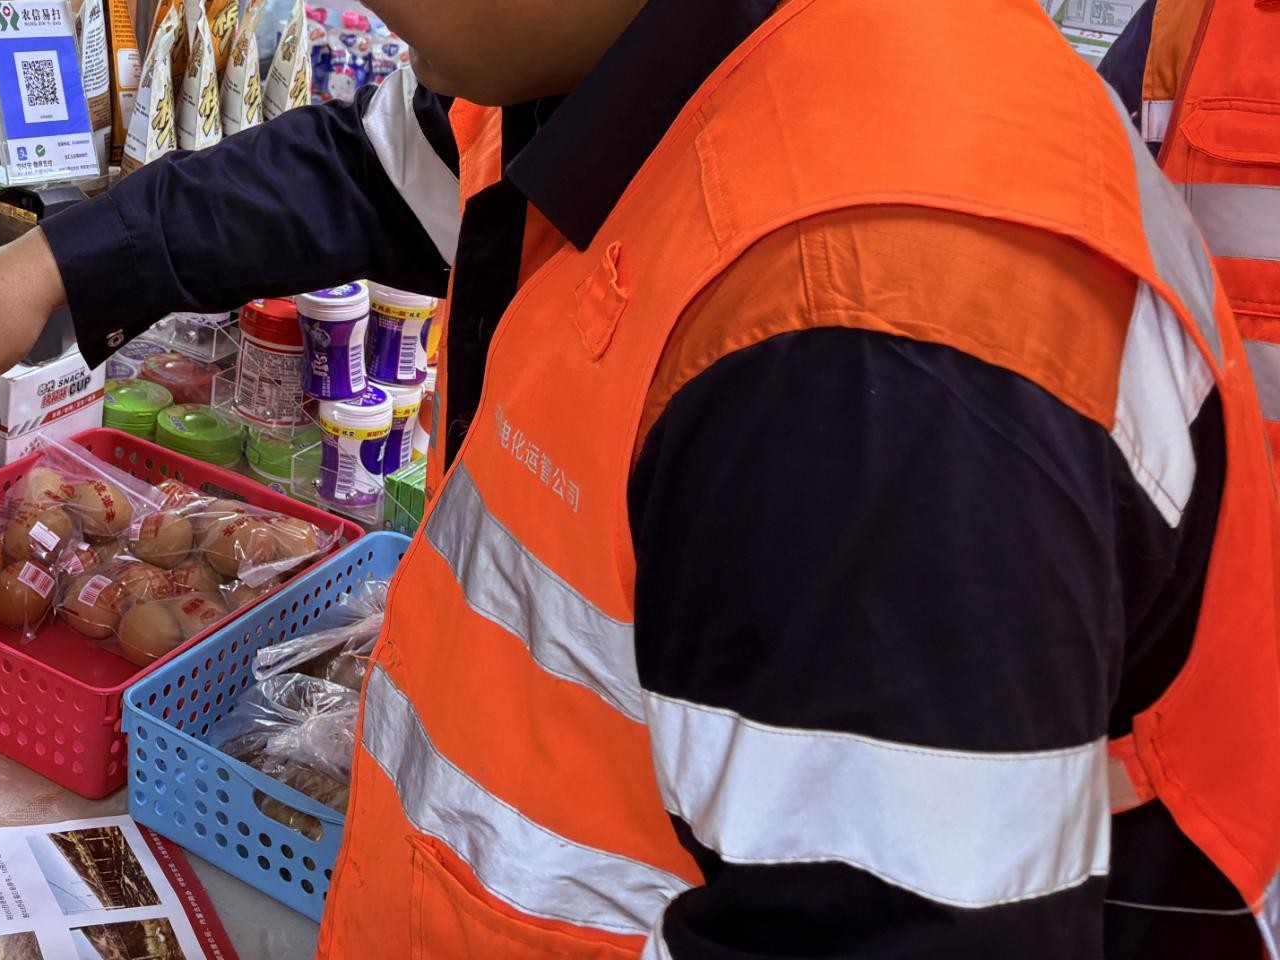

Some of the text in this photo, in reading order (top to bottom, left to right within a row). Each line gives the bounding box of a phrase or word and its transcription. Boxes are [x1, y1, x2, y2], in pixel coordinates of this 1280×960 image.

[21, 7, 61, 21] 农信易扫
[58, 370, 86, 388] SNACK
[69, 376, 91, 398] CUP
